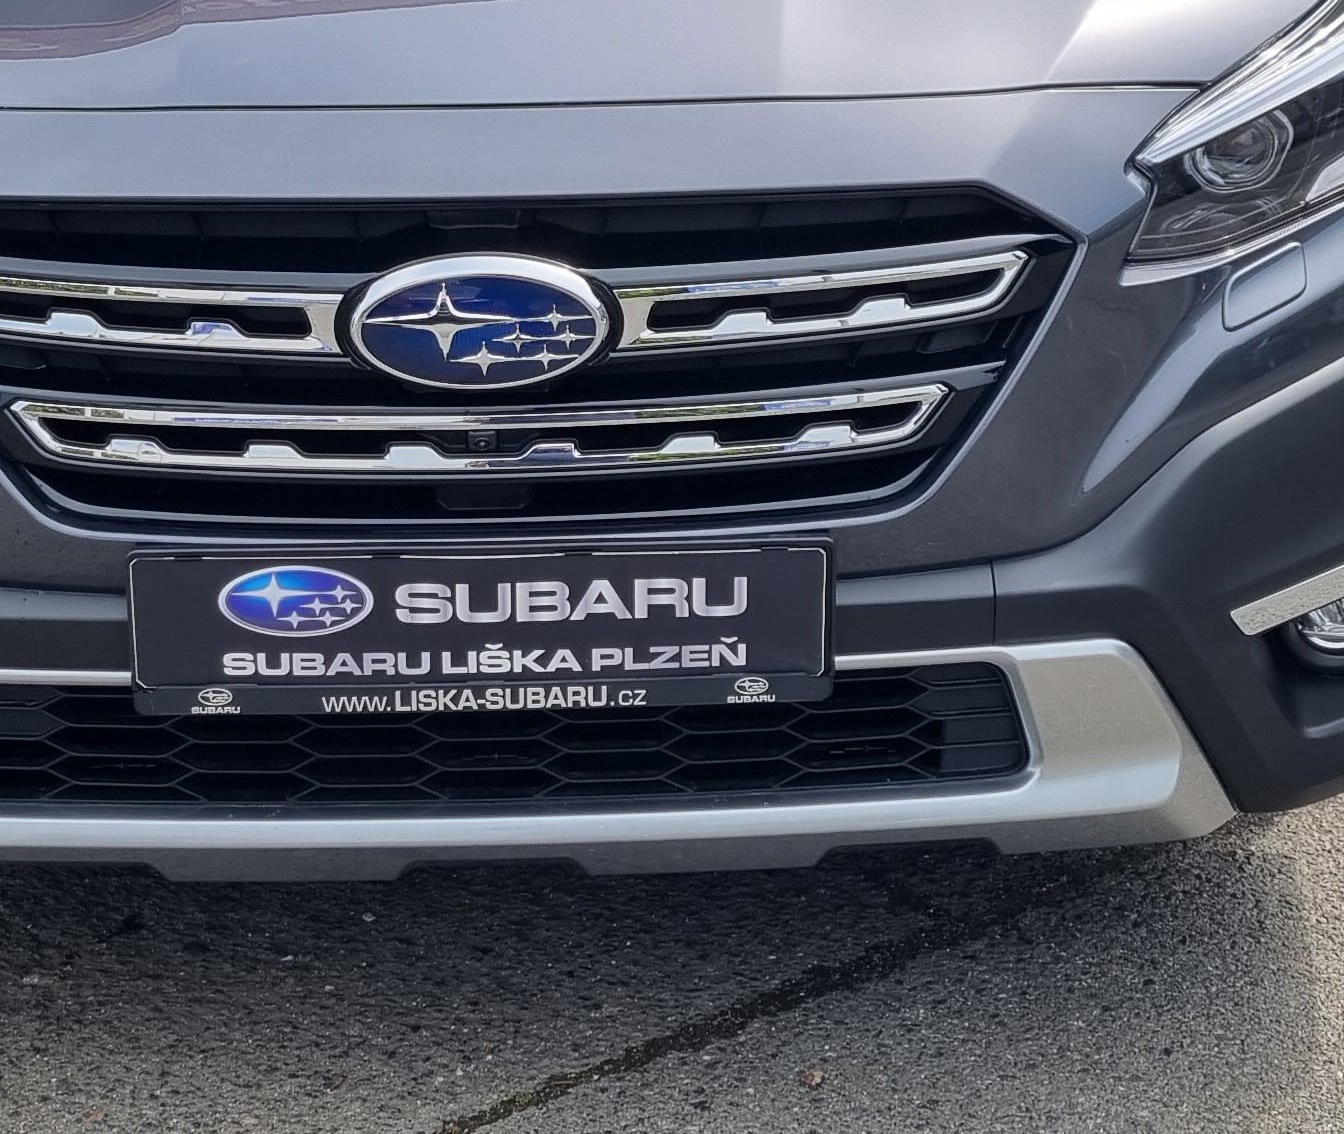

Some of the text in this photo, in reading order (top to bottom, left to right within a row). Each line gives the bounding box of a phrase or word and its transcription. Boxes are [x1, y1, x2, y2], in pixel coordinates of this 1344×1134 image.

[394, 576, 748, 624] SUBARU
[222, 636, 748, 676] SUBARU LIŠKA PLZEŇ
[190, 704, 241, 715] SUBARU
[321, 685, 647, 714] www.LISKA-SUBARU.cz
[726, 692, 776, 704] SUBARU
